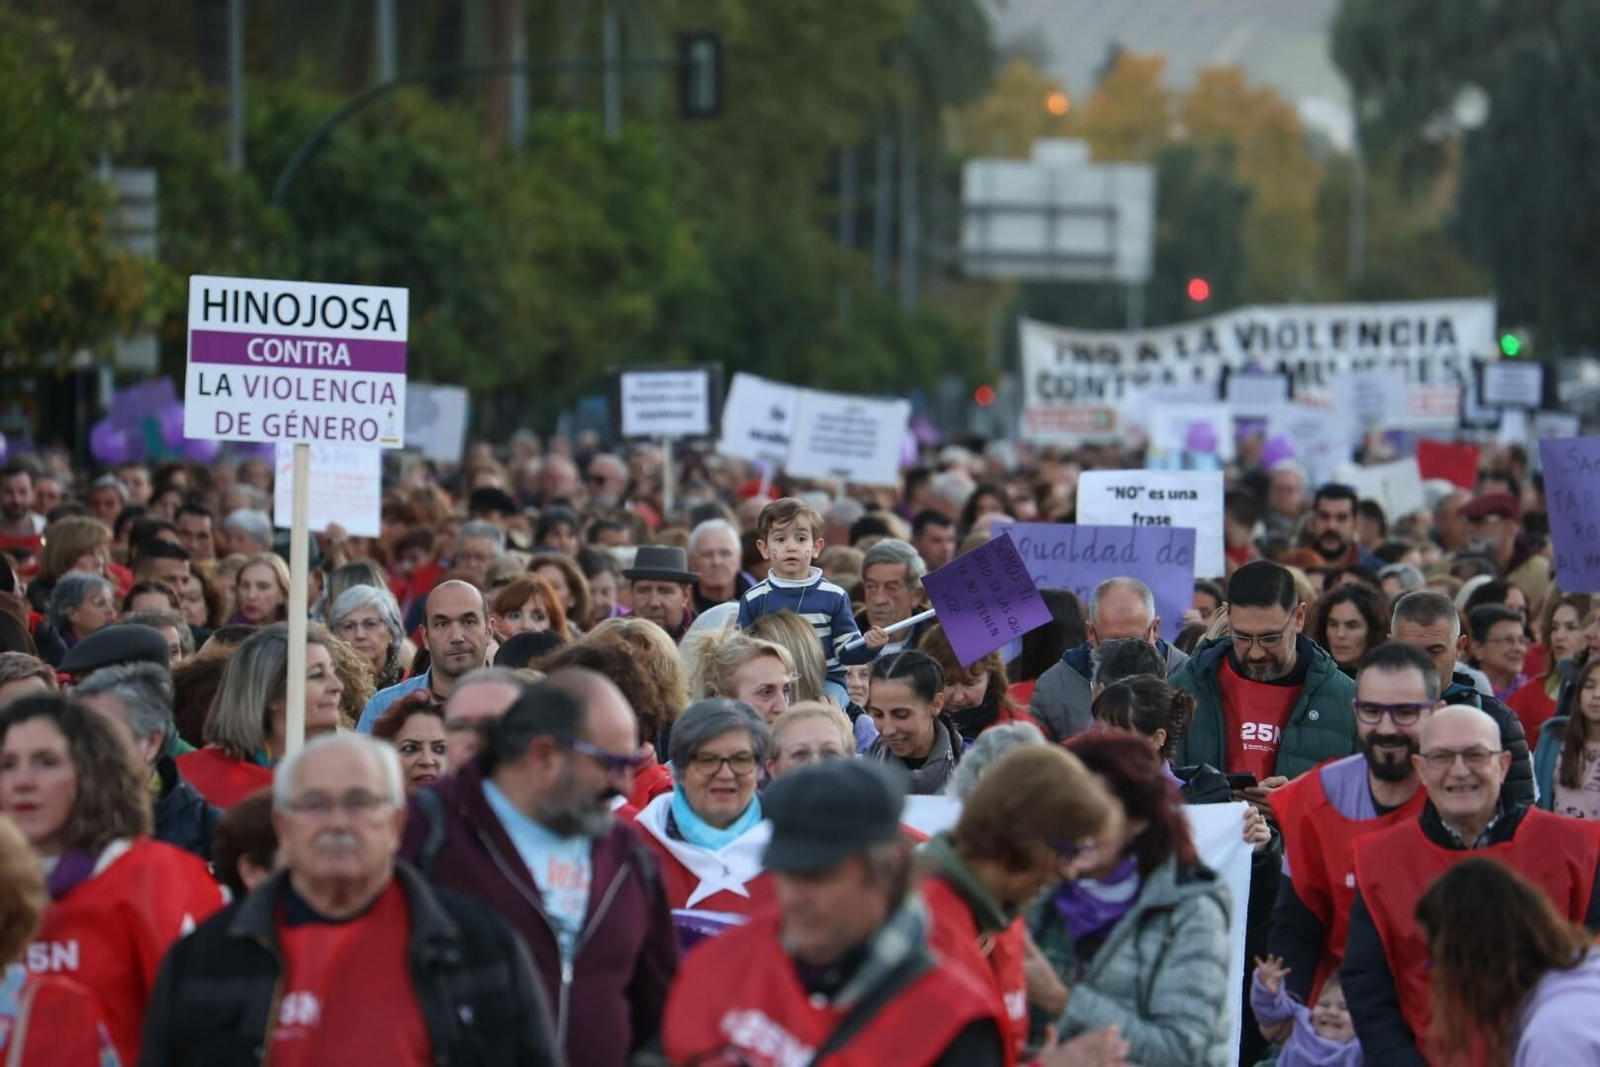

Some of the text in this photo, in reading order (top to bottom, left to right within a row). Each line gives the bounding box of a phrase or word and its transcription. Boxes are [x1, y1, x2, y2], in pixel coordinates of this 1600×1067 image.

[202, 288, 397, 332] HINOJOSA
[1235, 316, 1458, 351] VIOLENCIA
[247, 337, 351, 366] CONTRA
[199, 372, 397, 406] LA VIOLENCIA
[214, 411, 251, 436] DE
[262, 409, 379, 442] GÉNERO
[1148, 489, 1165, 500] es
[1168, 489, 1198, 500] una
[1131, 511, 1172, 526] frase
[1155, 529, 1190, 566] de
